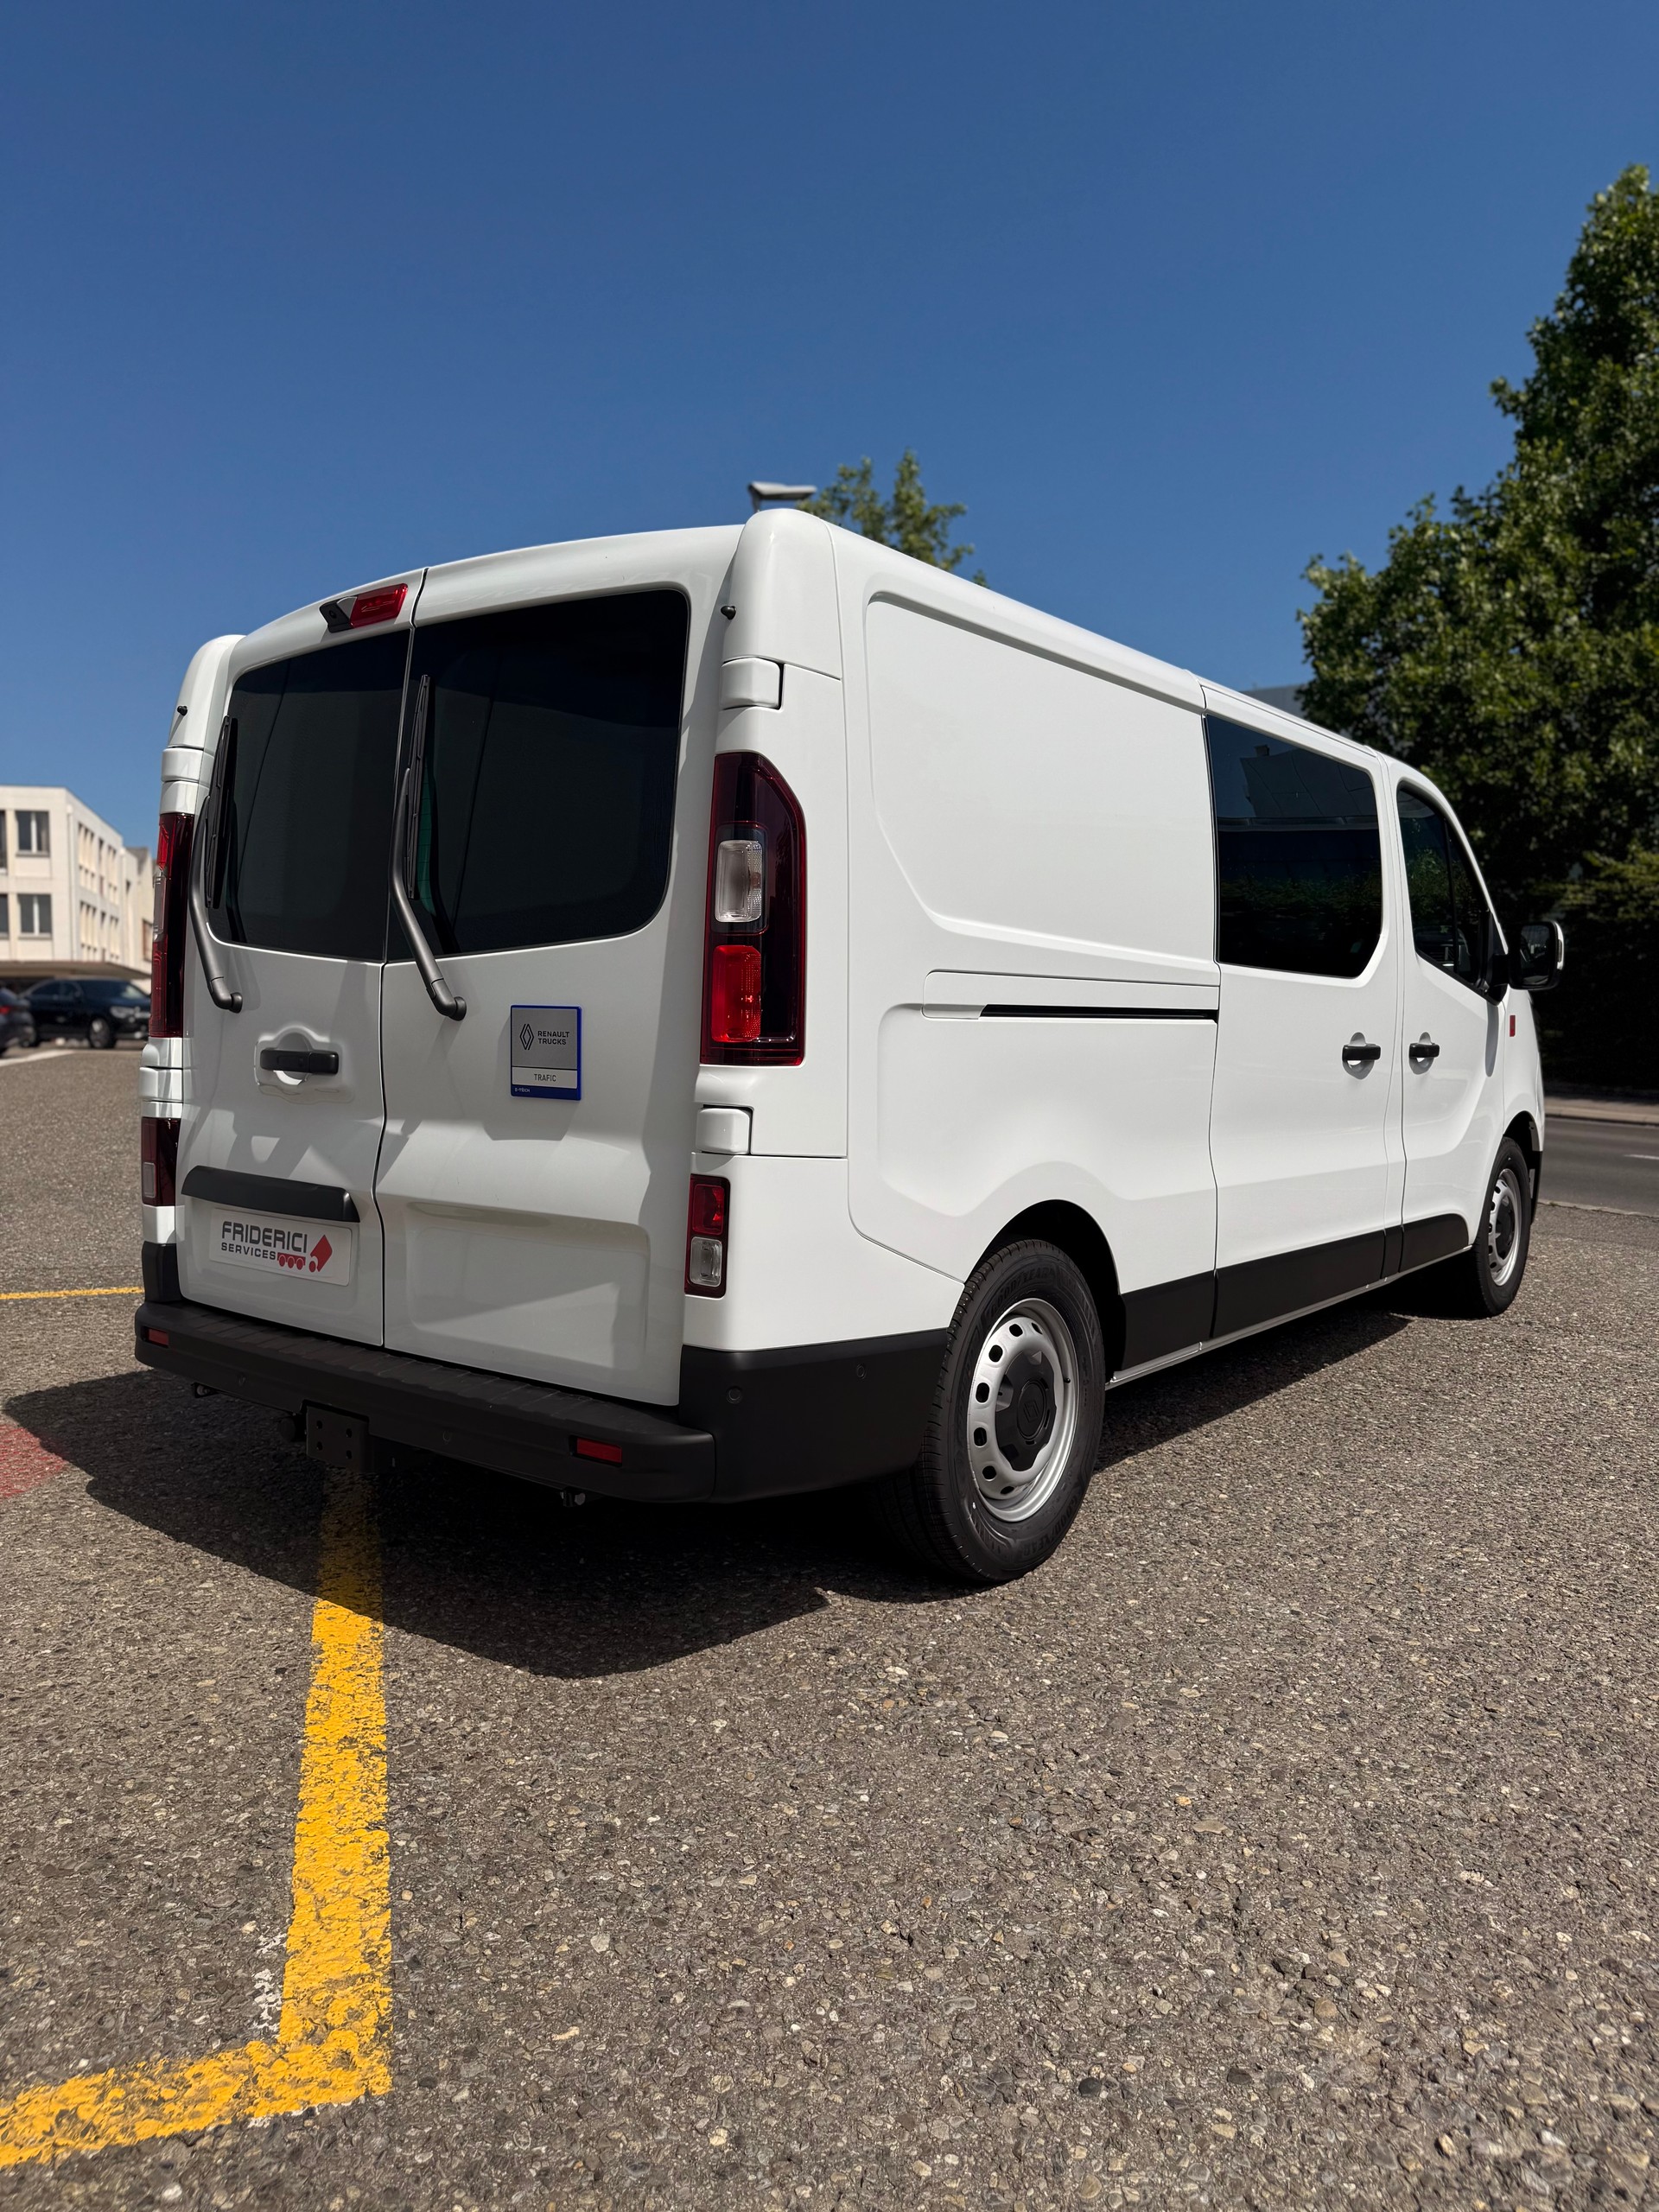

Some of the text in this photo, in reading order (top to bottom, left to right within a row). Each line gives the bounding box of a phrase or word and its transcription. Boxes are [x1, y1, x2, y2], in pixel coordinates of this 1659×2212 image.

[534, 1073, 556, 1082] TRAFIC
[222, 1221, 308, 1253] FRIDERICI
[221, 1242, 276, 1261] SERVICES
